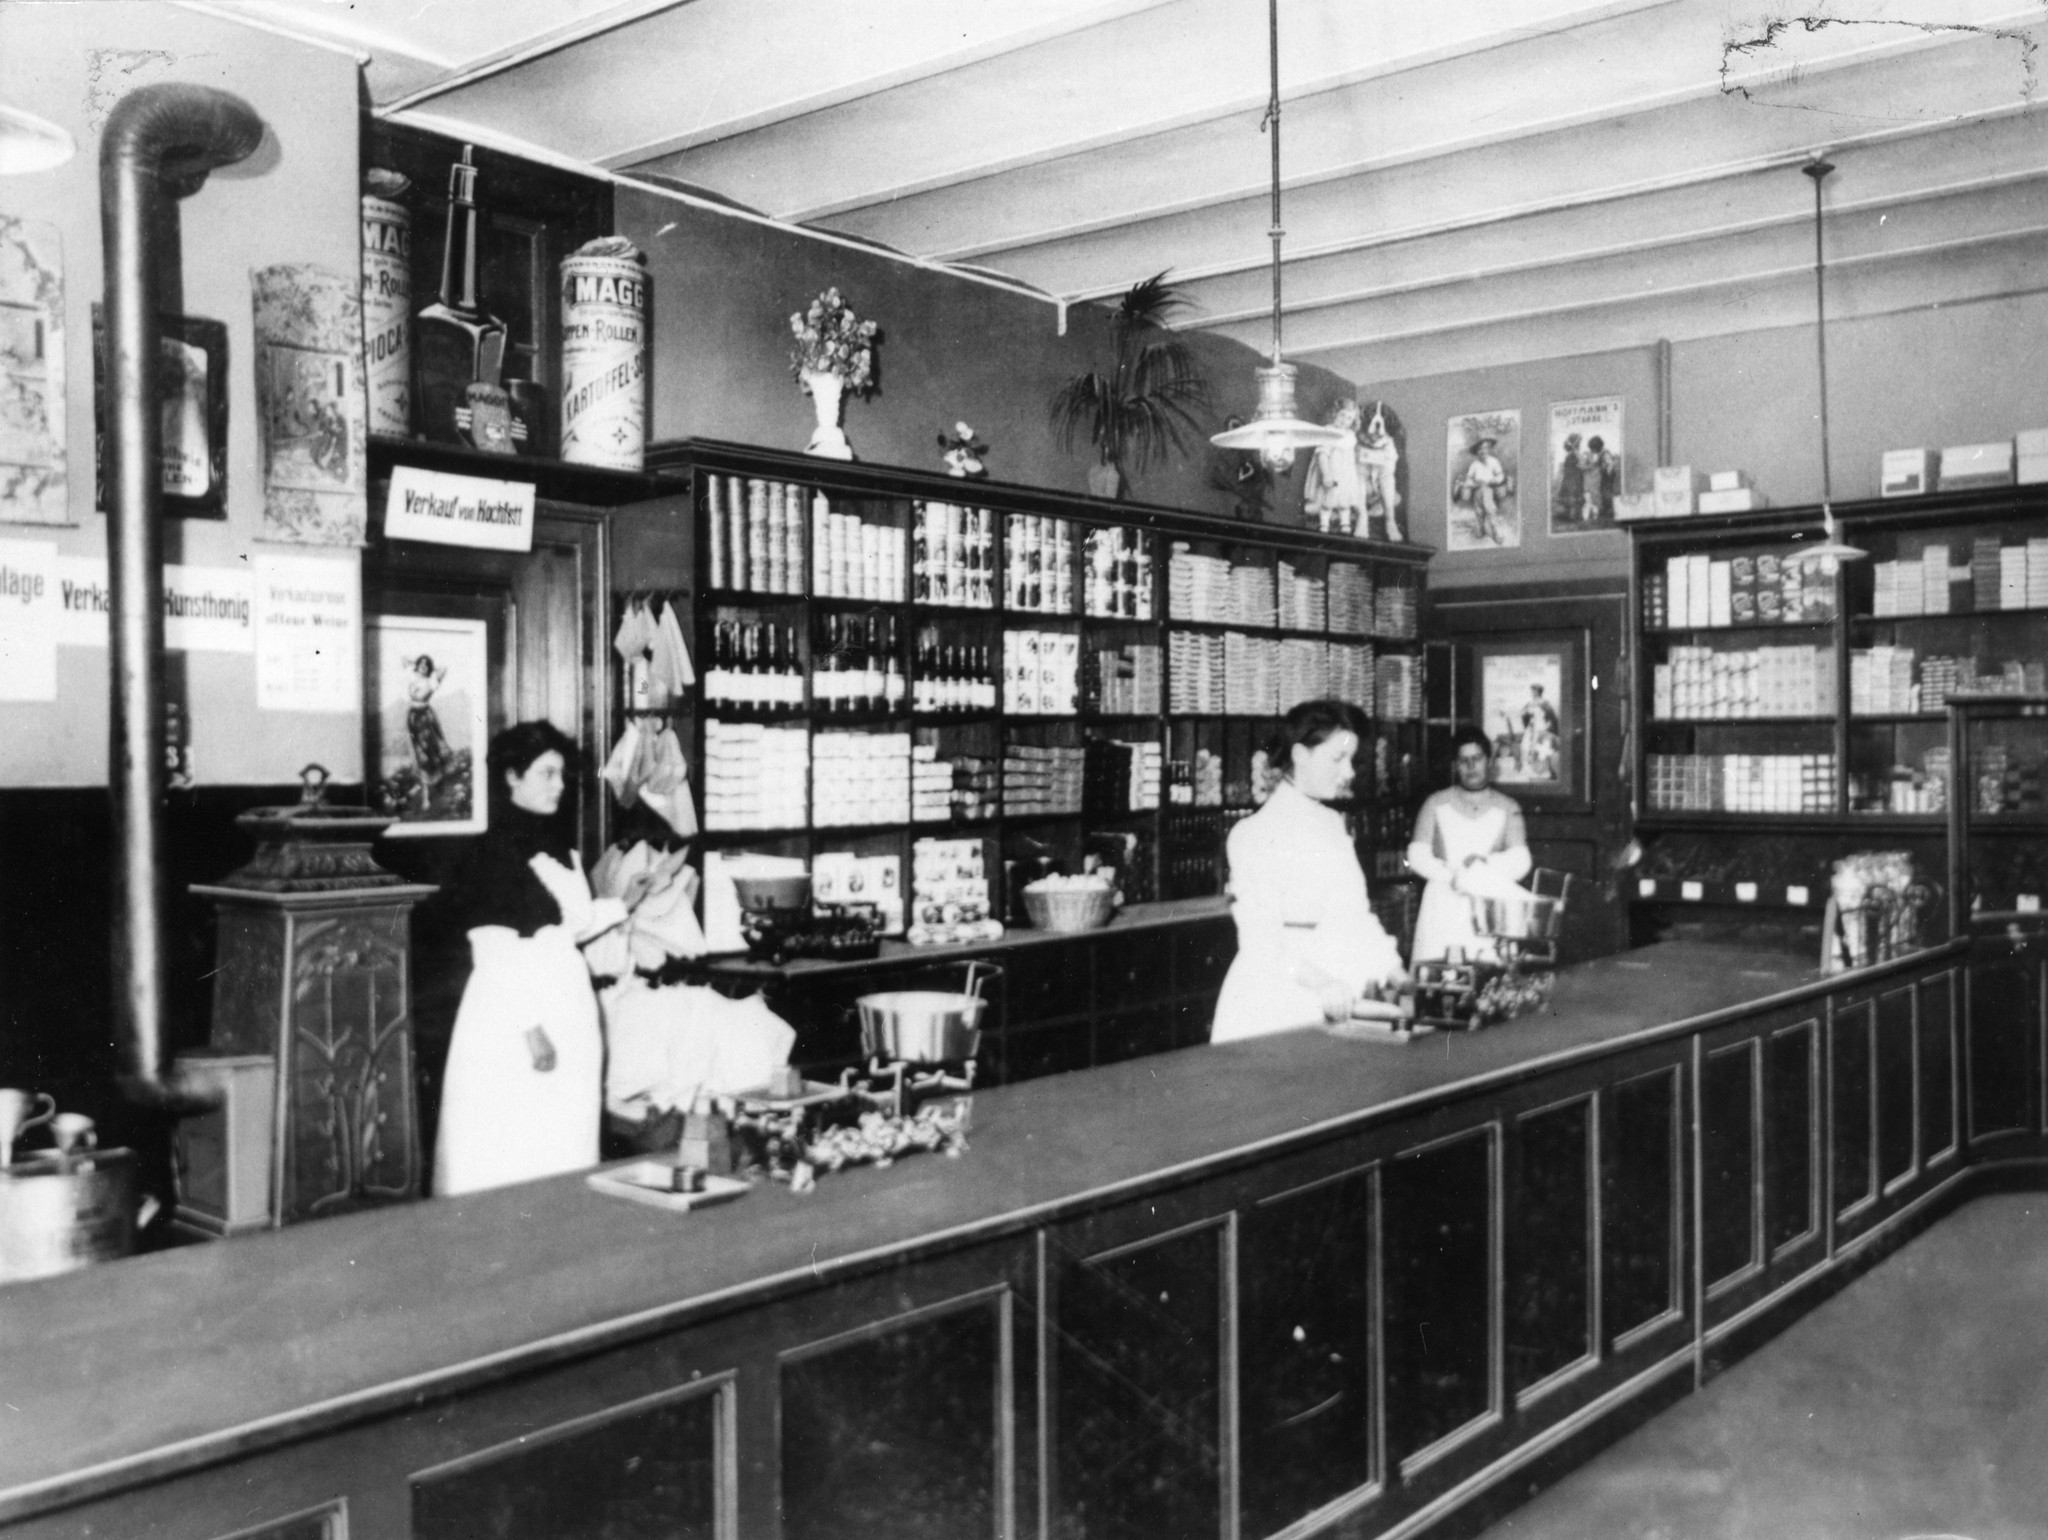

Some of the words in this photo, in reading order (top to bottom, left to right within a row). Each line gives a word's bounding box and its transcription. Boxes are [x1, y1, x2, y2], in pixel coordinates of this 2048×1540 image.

[576, 276, 644, 308] MAGG
[405, 488, 460, 519] Verkauf
[458, 505, 475, 521] von
[0, 564, 44, 604] läge
[164, 586, 250, 627] Kunsthonig
